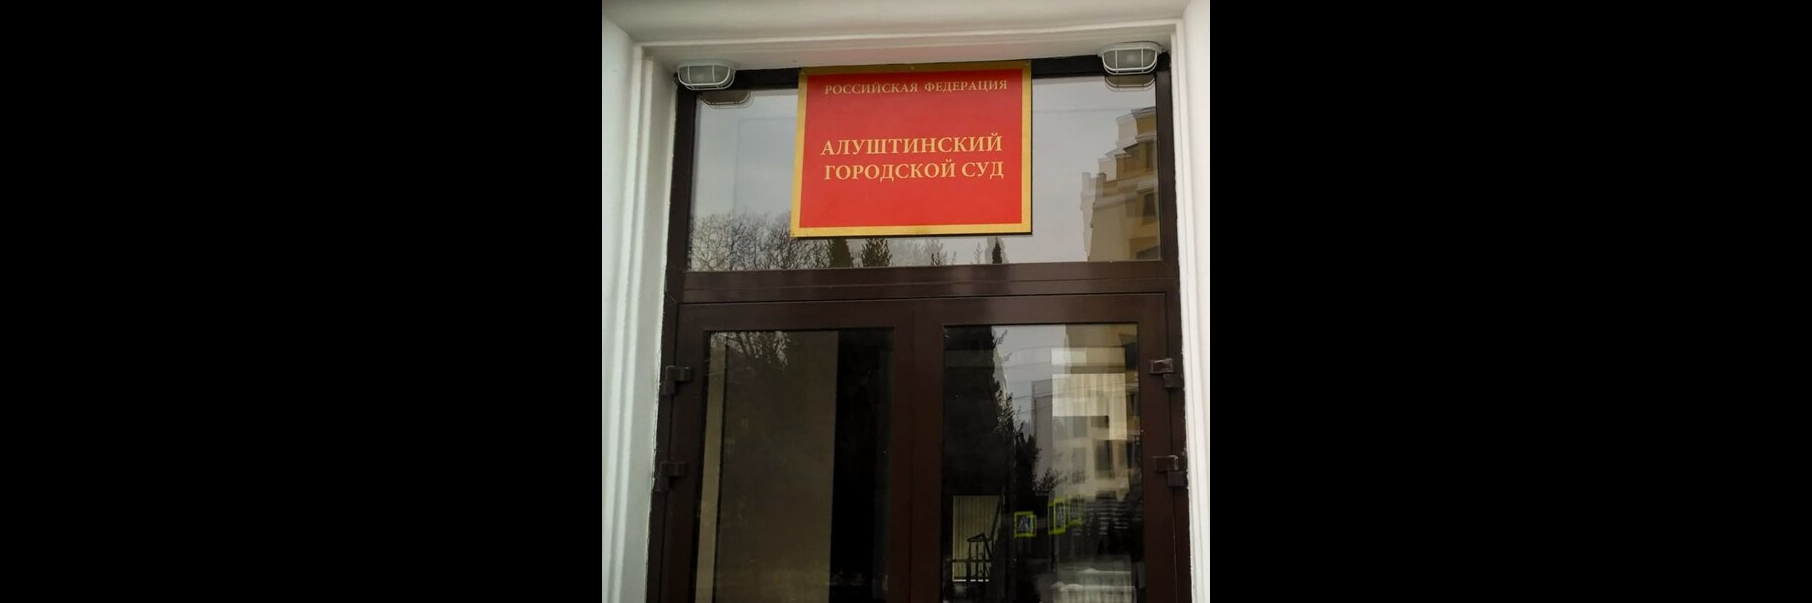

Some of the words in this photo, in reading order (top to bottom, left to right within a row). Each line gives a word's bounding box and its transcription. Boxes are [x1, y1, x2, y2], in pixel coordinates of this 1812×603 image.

[824, 81, 918, 95] РОССИЙСКАЯ
[924, 80, 1008, 94] ФЕДЕРАЦИЯ
[820, 133, 1003, 156] АЛУШТИНСКИЙ
[824, 158, 956, 182] ГОРОДСКОЙ
[961, 161, 1004, 179] СУД
